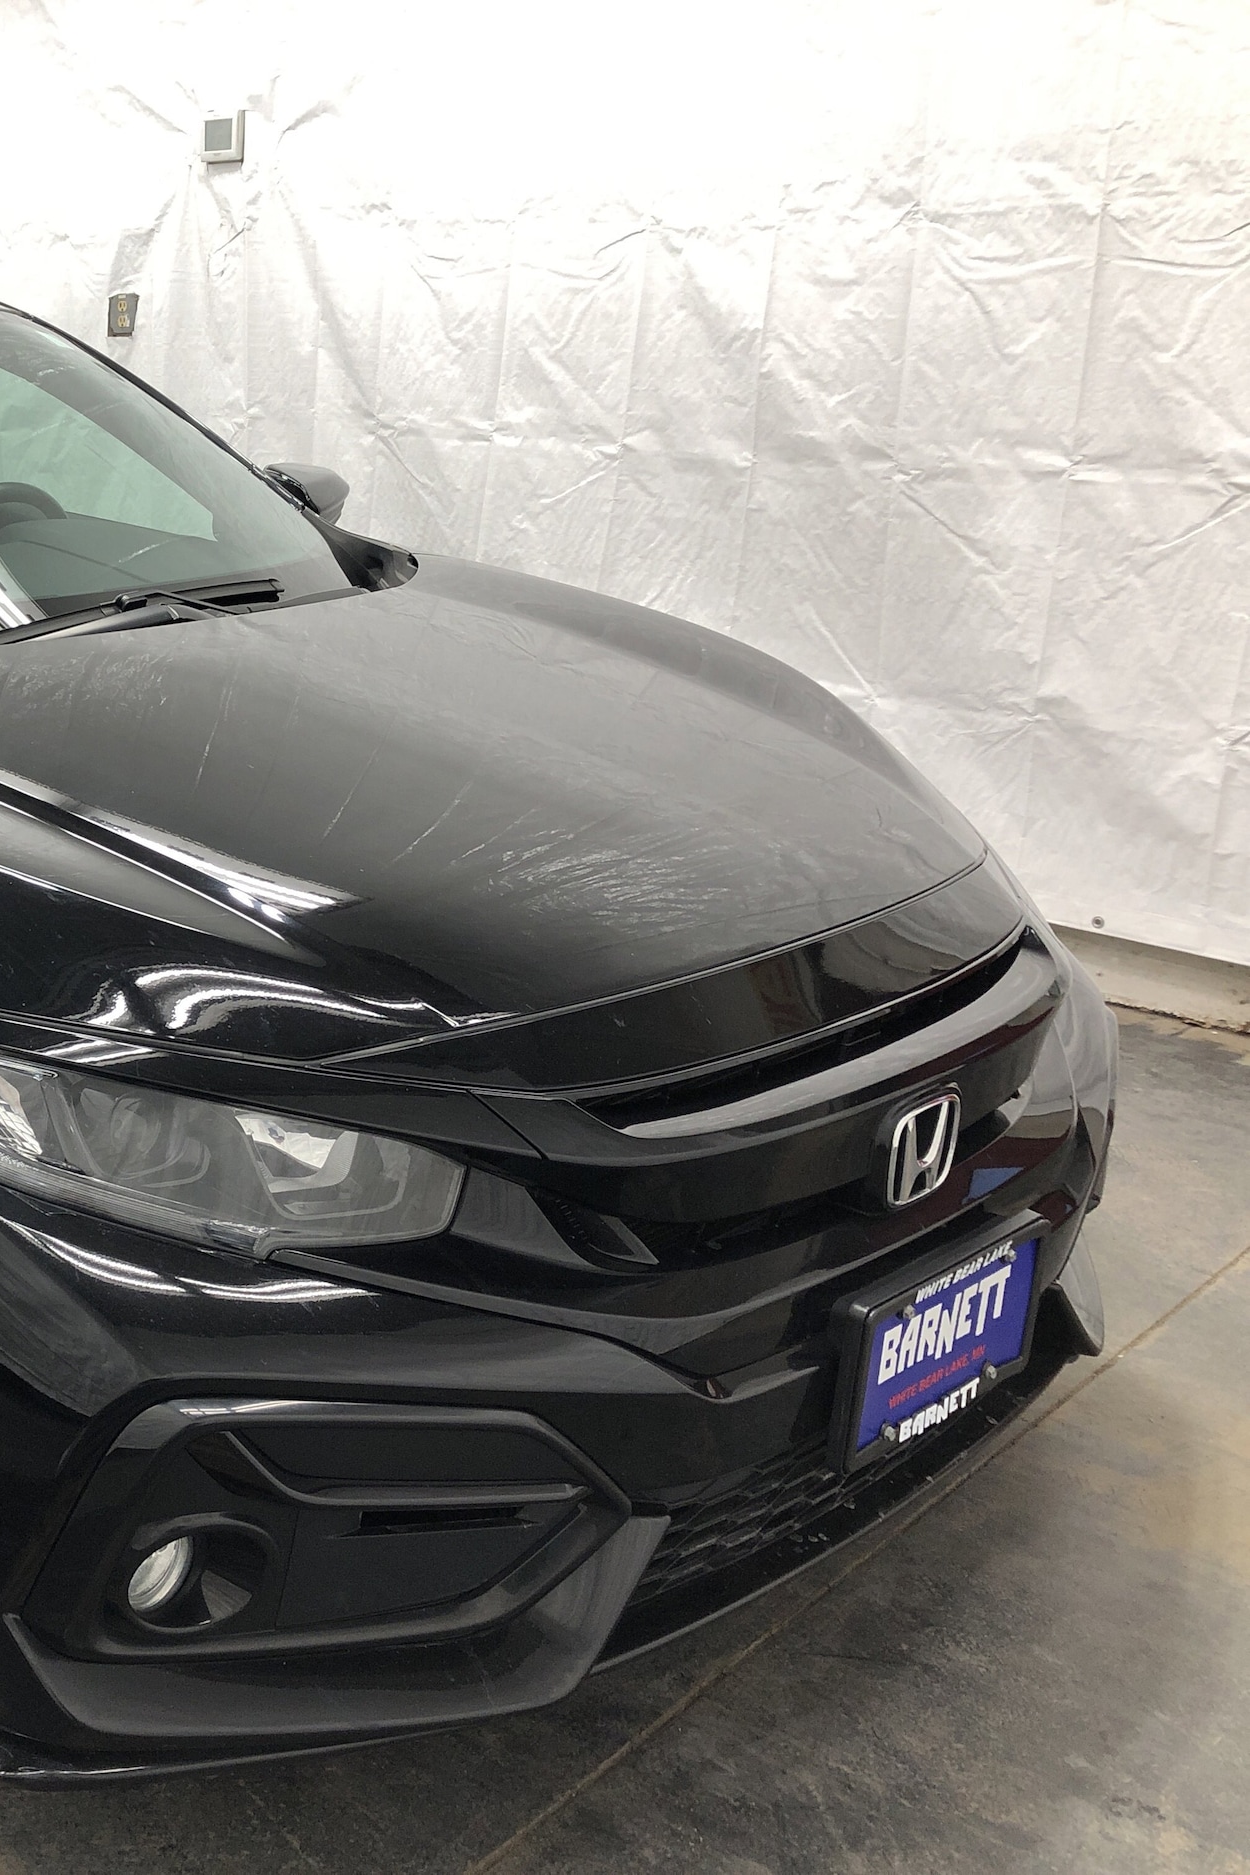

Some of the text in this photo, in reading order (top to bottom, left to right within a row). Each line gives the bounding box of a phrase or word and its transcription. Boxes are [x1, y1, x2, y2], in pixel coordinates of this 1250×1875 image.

[915, 1240, 1013, 1304] WHITE BEAR LAKE
[877, 1263, 1012, 1386] BARNETT
[888, 1382, 918, 1409] WHITE
[918, 1367, 944, 1393] BEAR
[898, 1376, 980, 1443] BARNETT
